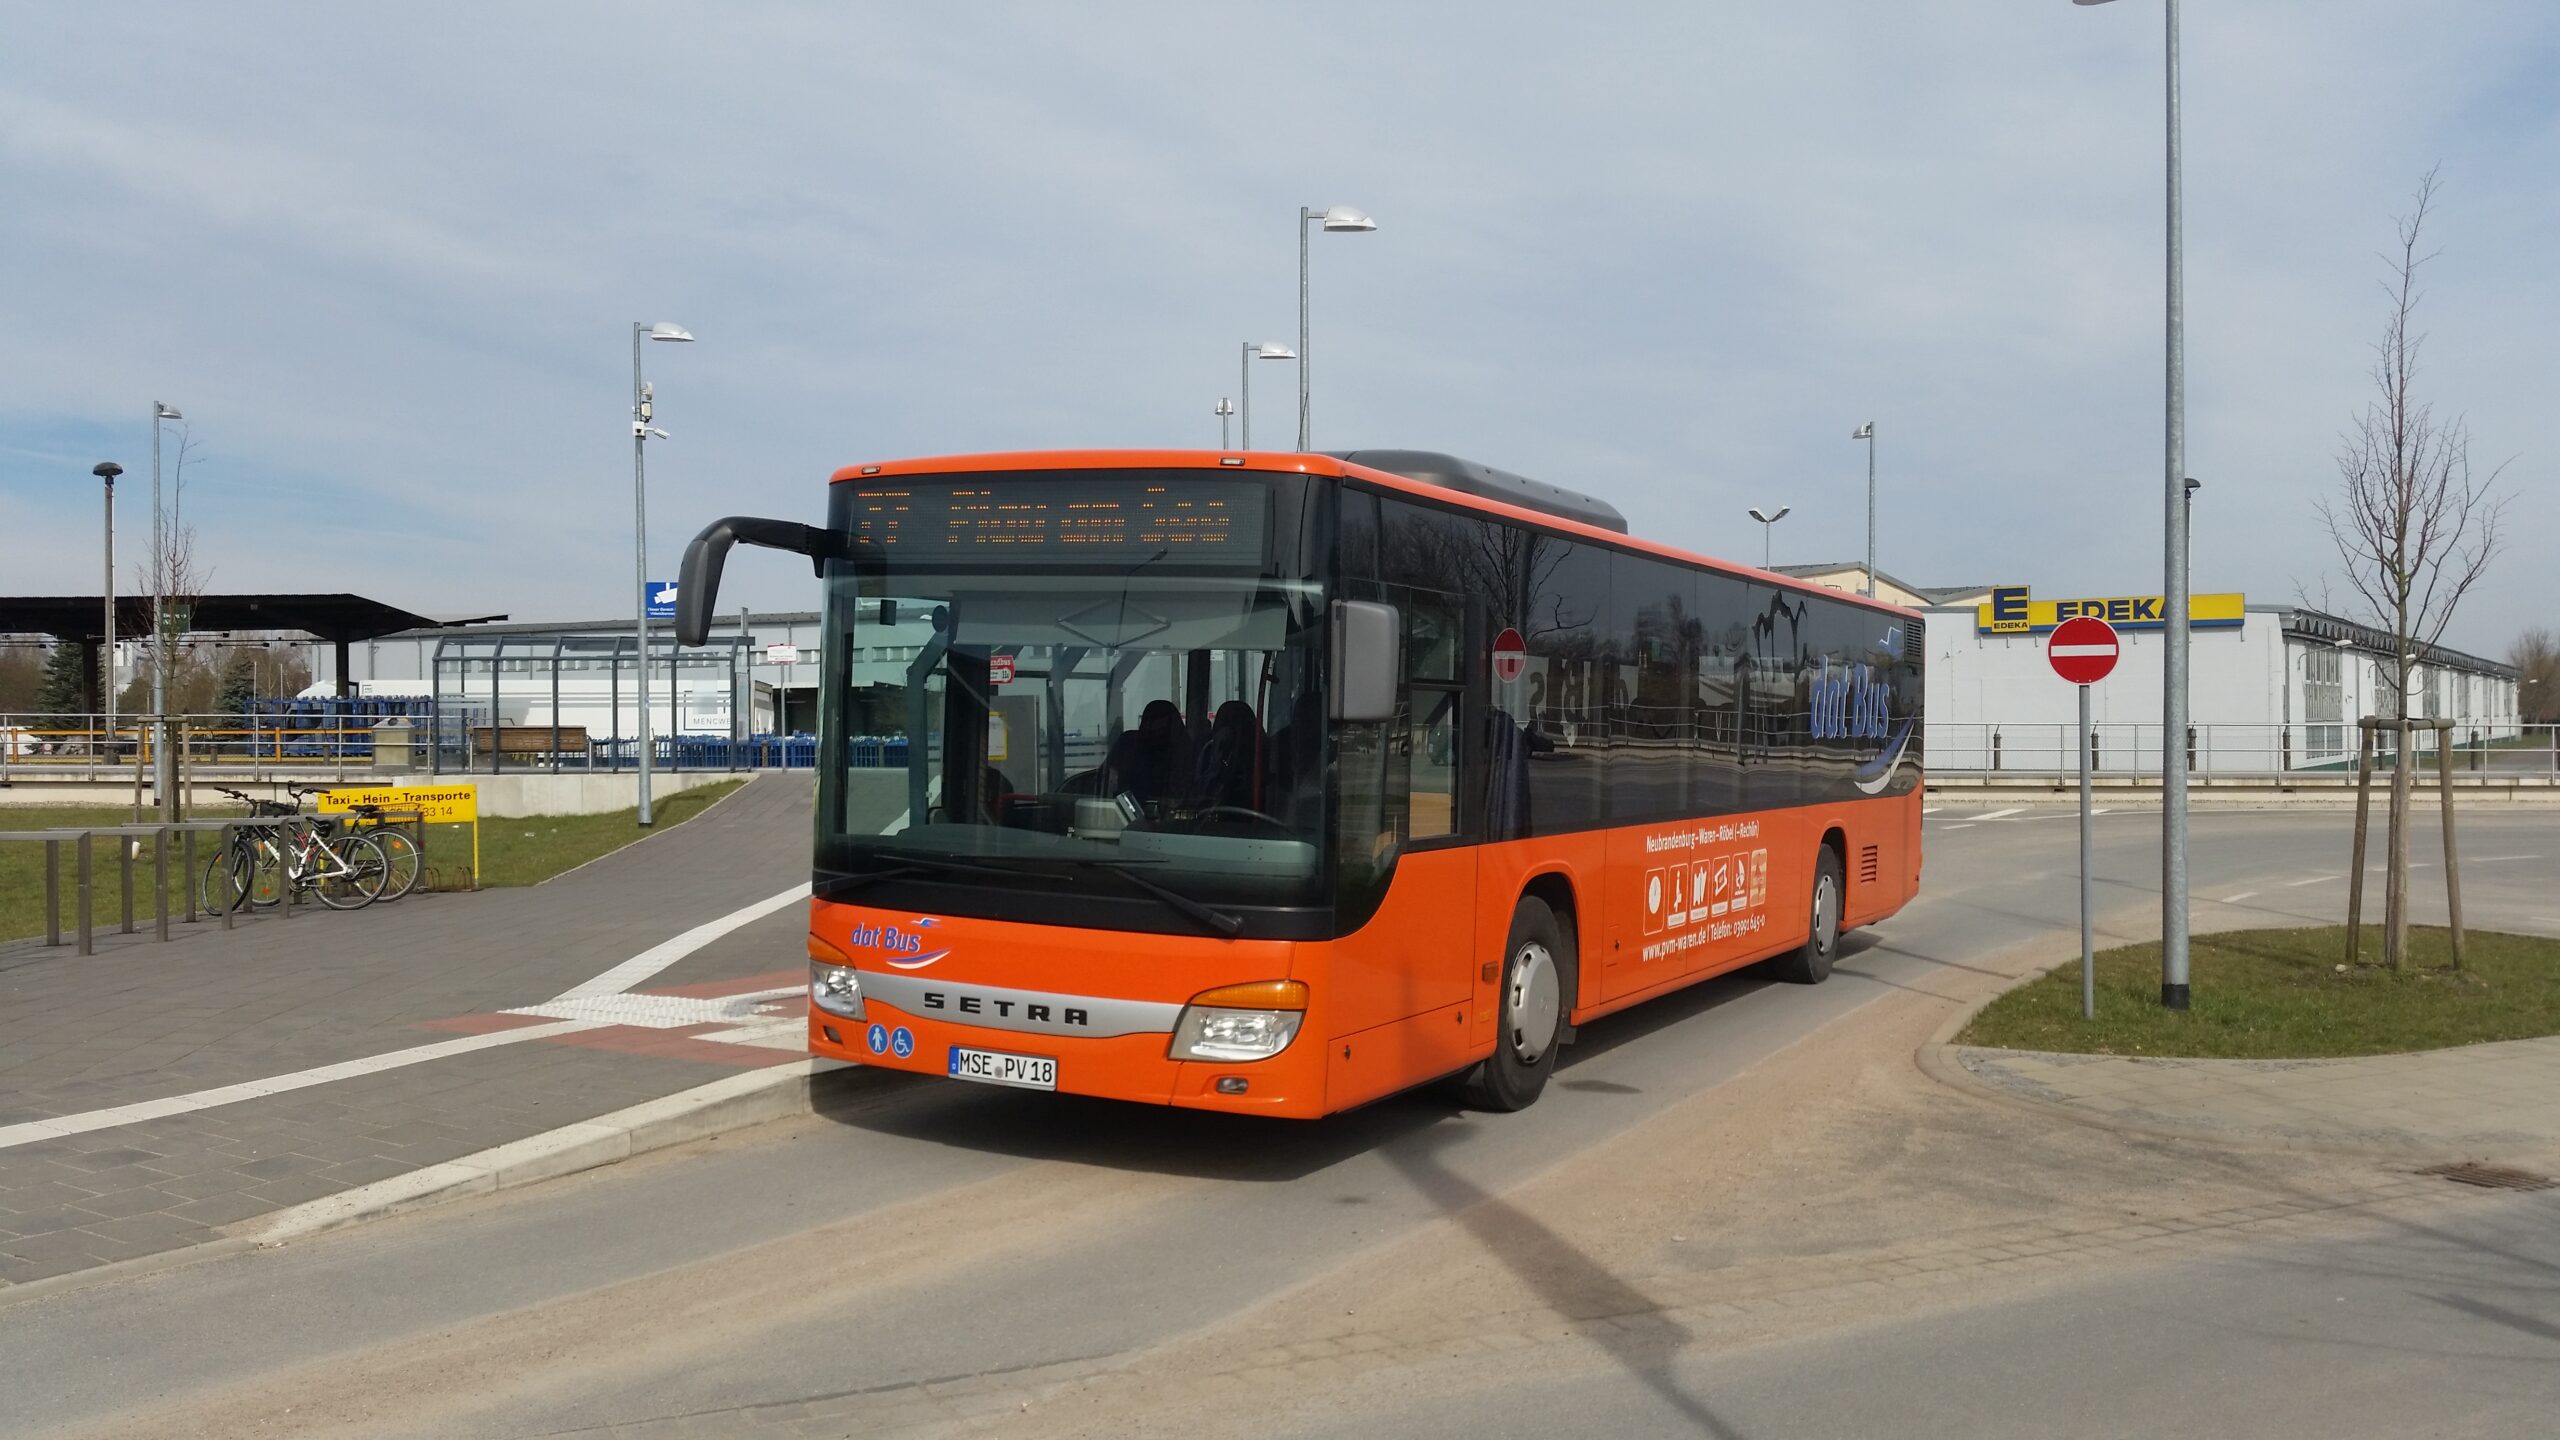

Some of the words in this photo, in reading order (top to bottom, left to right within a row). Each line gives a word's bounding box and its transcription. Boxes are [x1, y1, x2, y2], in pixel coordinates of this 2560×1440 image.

[2057, 598, 2165, 622] EDEK
[1811, 654, 1850, 739] dat
[1852, 663, 1889, 739] Bus
[326, 793, 350, 804] Taxi
[363, 793, 390, 804] Hein
[402, 791, 471, 803] Transporte
[851, 921, 882, 949] dat
[884, 926, 921, 952] Bus
[1710, 921, 1732, 941] Telefon:
[924, 992, 1088, 1026] SETRA
[959, 1052, 992, 1076] MSE
